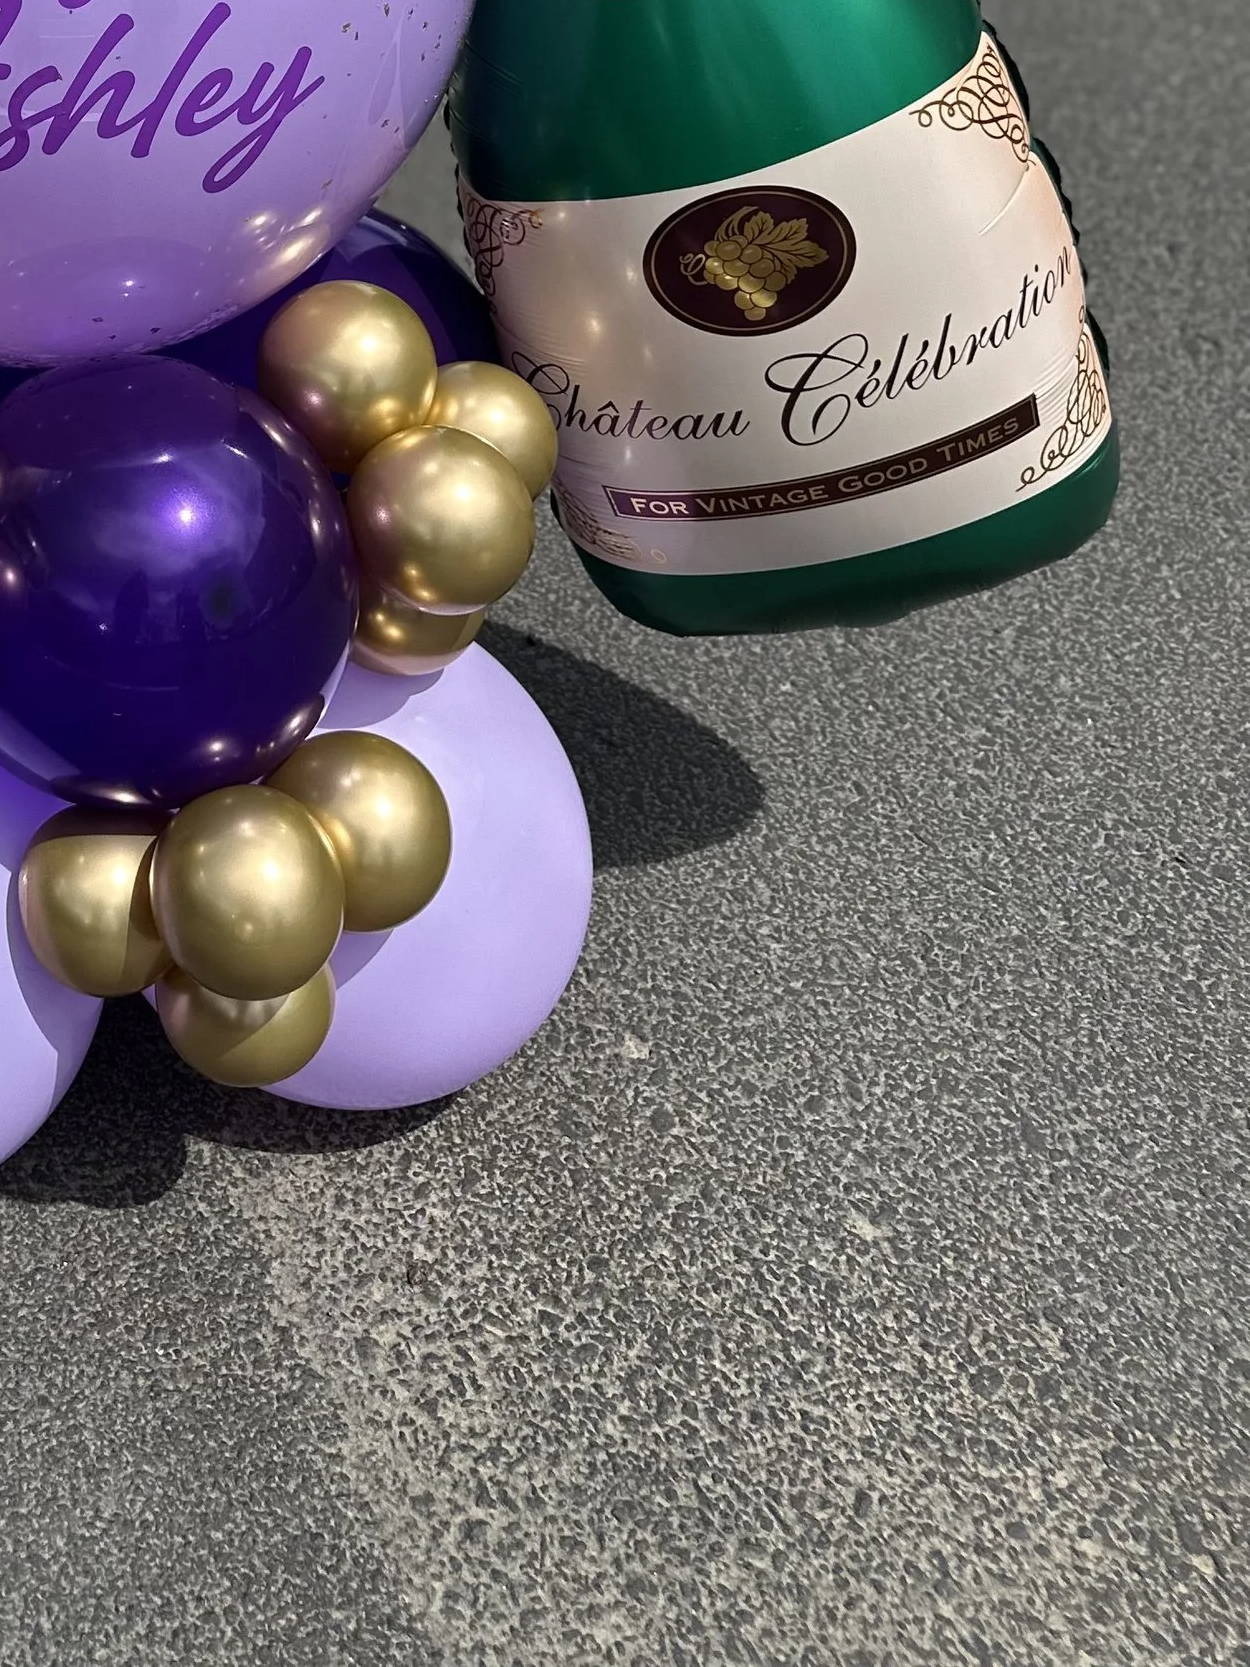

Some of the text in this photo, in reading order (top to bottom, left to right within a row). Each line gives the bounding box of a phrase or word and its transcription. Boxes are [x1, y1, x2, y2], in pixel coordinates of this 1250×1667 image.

[511, 245, 1071, 447] Château Célébration
[630, 416, 1020, 515] FOR VINTAGE GOOD TIMES
